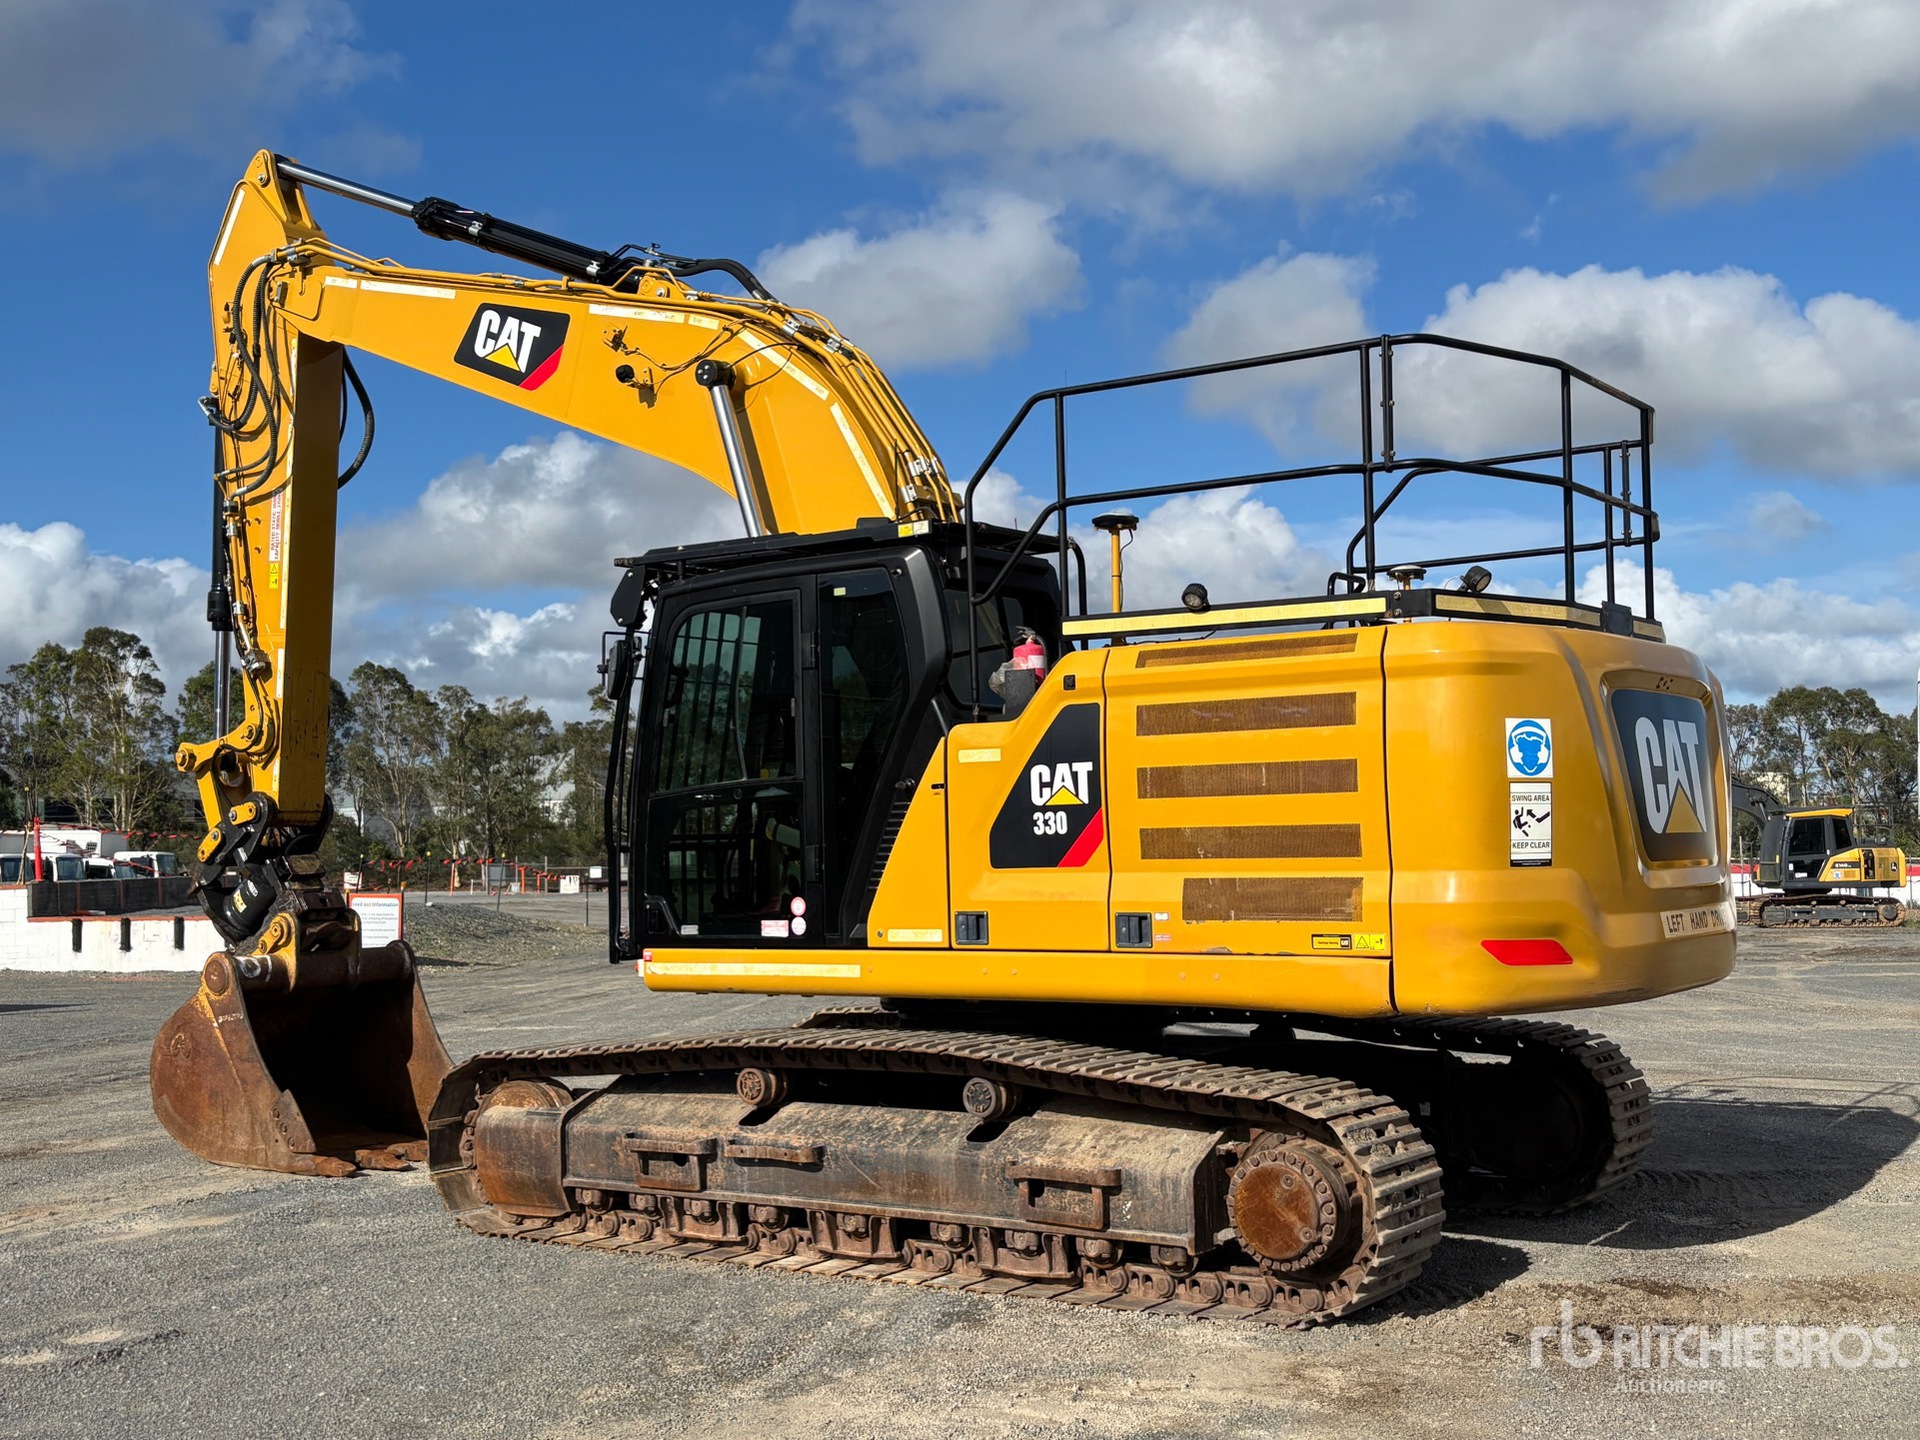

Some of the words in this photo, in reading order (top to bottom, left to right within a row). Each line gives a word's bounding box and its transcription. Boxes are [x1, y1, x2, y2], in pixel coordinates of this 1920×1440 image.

[474, 309, 542, 374] CAT
[1030, 761, 1093, 806] CAT
[1635, 716, 1707, 834] CAT
[1033, 811, 1068, 835] 330
[1530, 841, 1550, 849] CLEAR
[1666, 913, 1685, 933] LEFT
[1690, 911, 1708, 931] HAND
